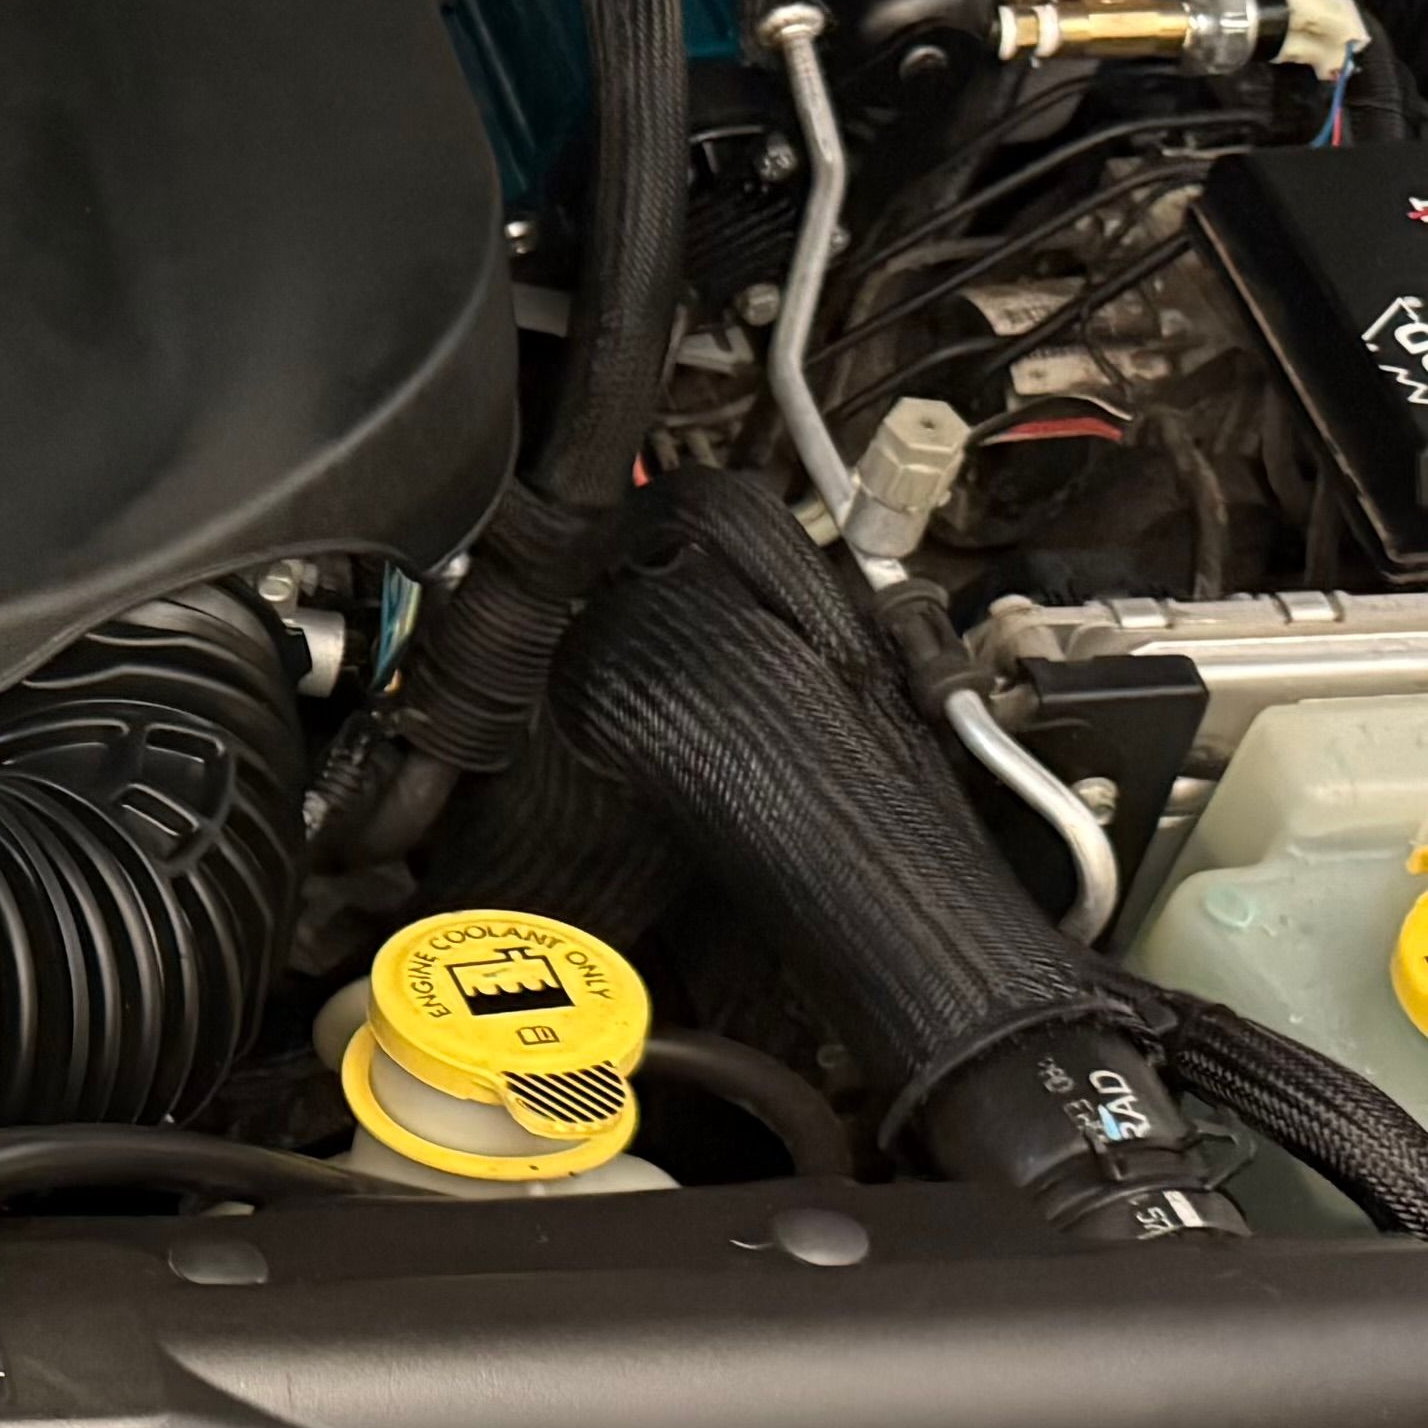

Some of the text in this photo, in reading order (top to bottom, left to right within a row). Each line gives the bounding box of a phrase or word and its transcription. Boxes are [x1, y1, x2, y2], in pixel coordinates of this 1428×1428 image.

[408, 924, 615, 1019] ENGINE COOLANT ONLY
